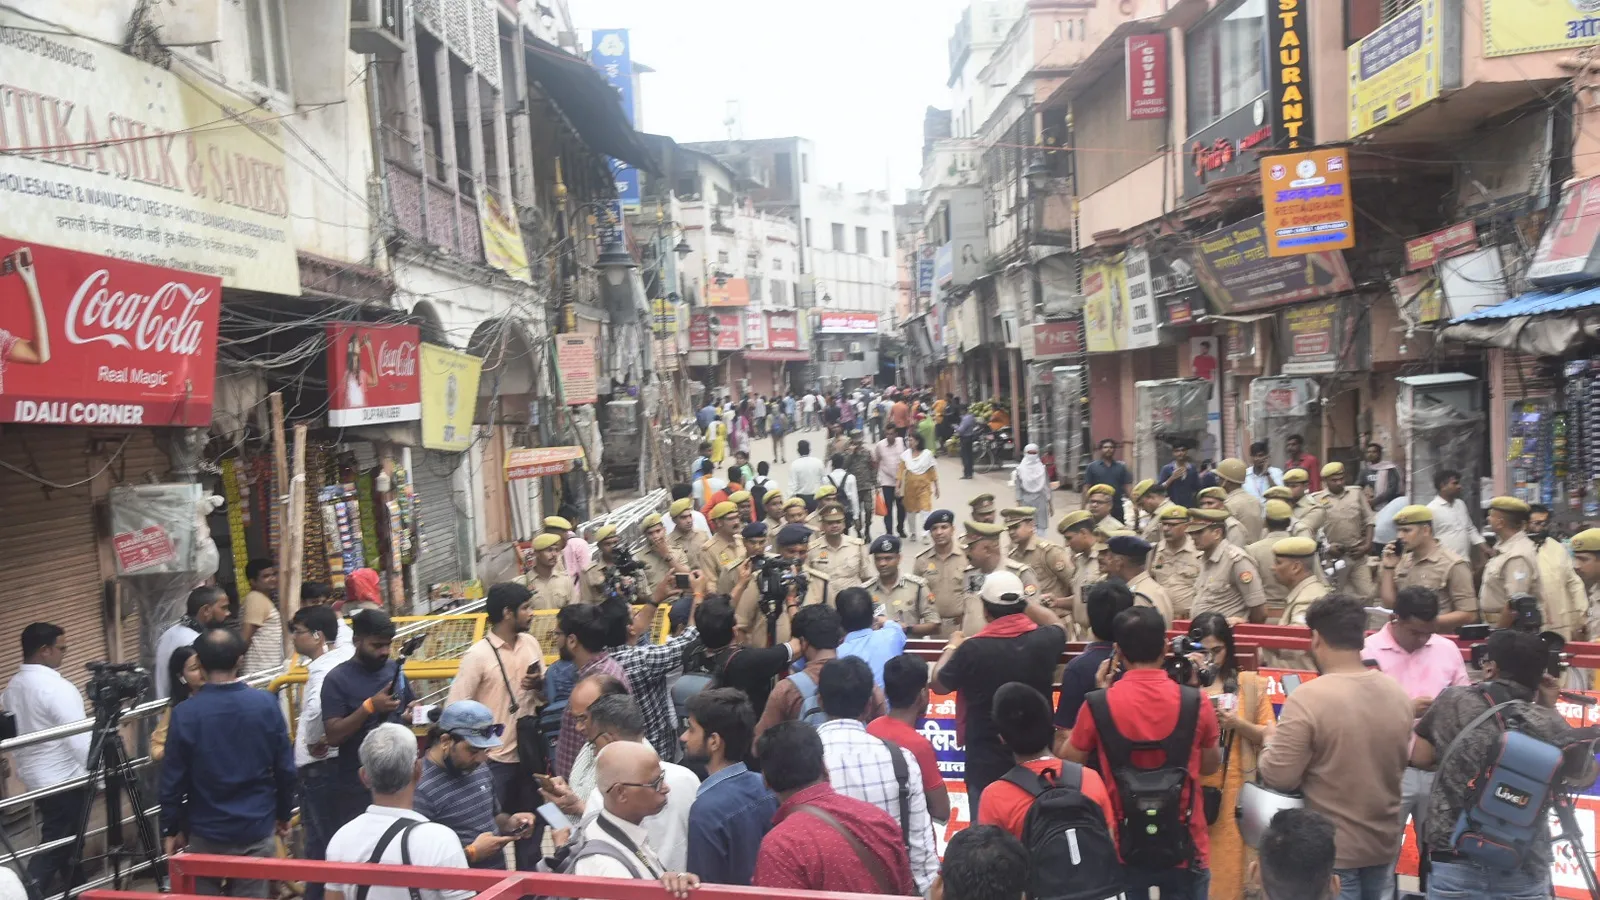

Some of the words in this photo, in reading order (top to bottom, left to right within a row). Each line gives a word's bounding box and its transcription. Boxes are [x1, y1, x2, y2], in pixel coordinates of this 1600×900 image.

[1141, 47, 1156, 95] GOVIND
[108, 112, 184, 192] SILK
[186, 134, 208, 199] &
[208, 143, 290, 219] SAREES
[1274, 199, 1345, 216] RESTAURANT
[65, 269, 213, 356] Coca-Cola
[377, 340, 417, 377] Coca-Cola
[97, 365, 128, 384] Real
[130, 367, 169, 388] Magic
[15, 400, 74, 423] IDALI
[74, 402, 144, 425] CORNER
[1494, 786, 1529, 806] LiveU
[1554, 861, 1582, 875] NY
